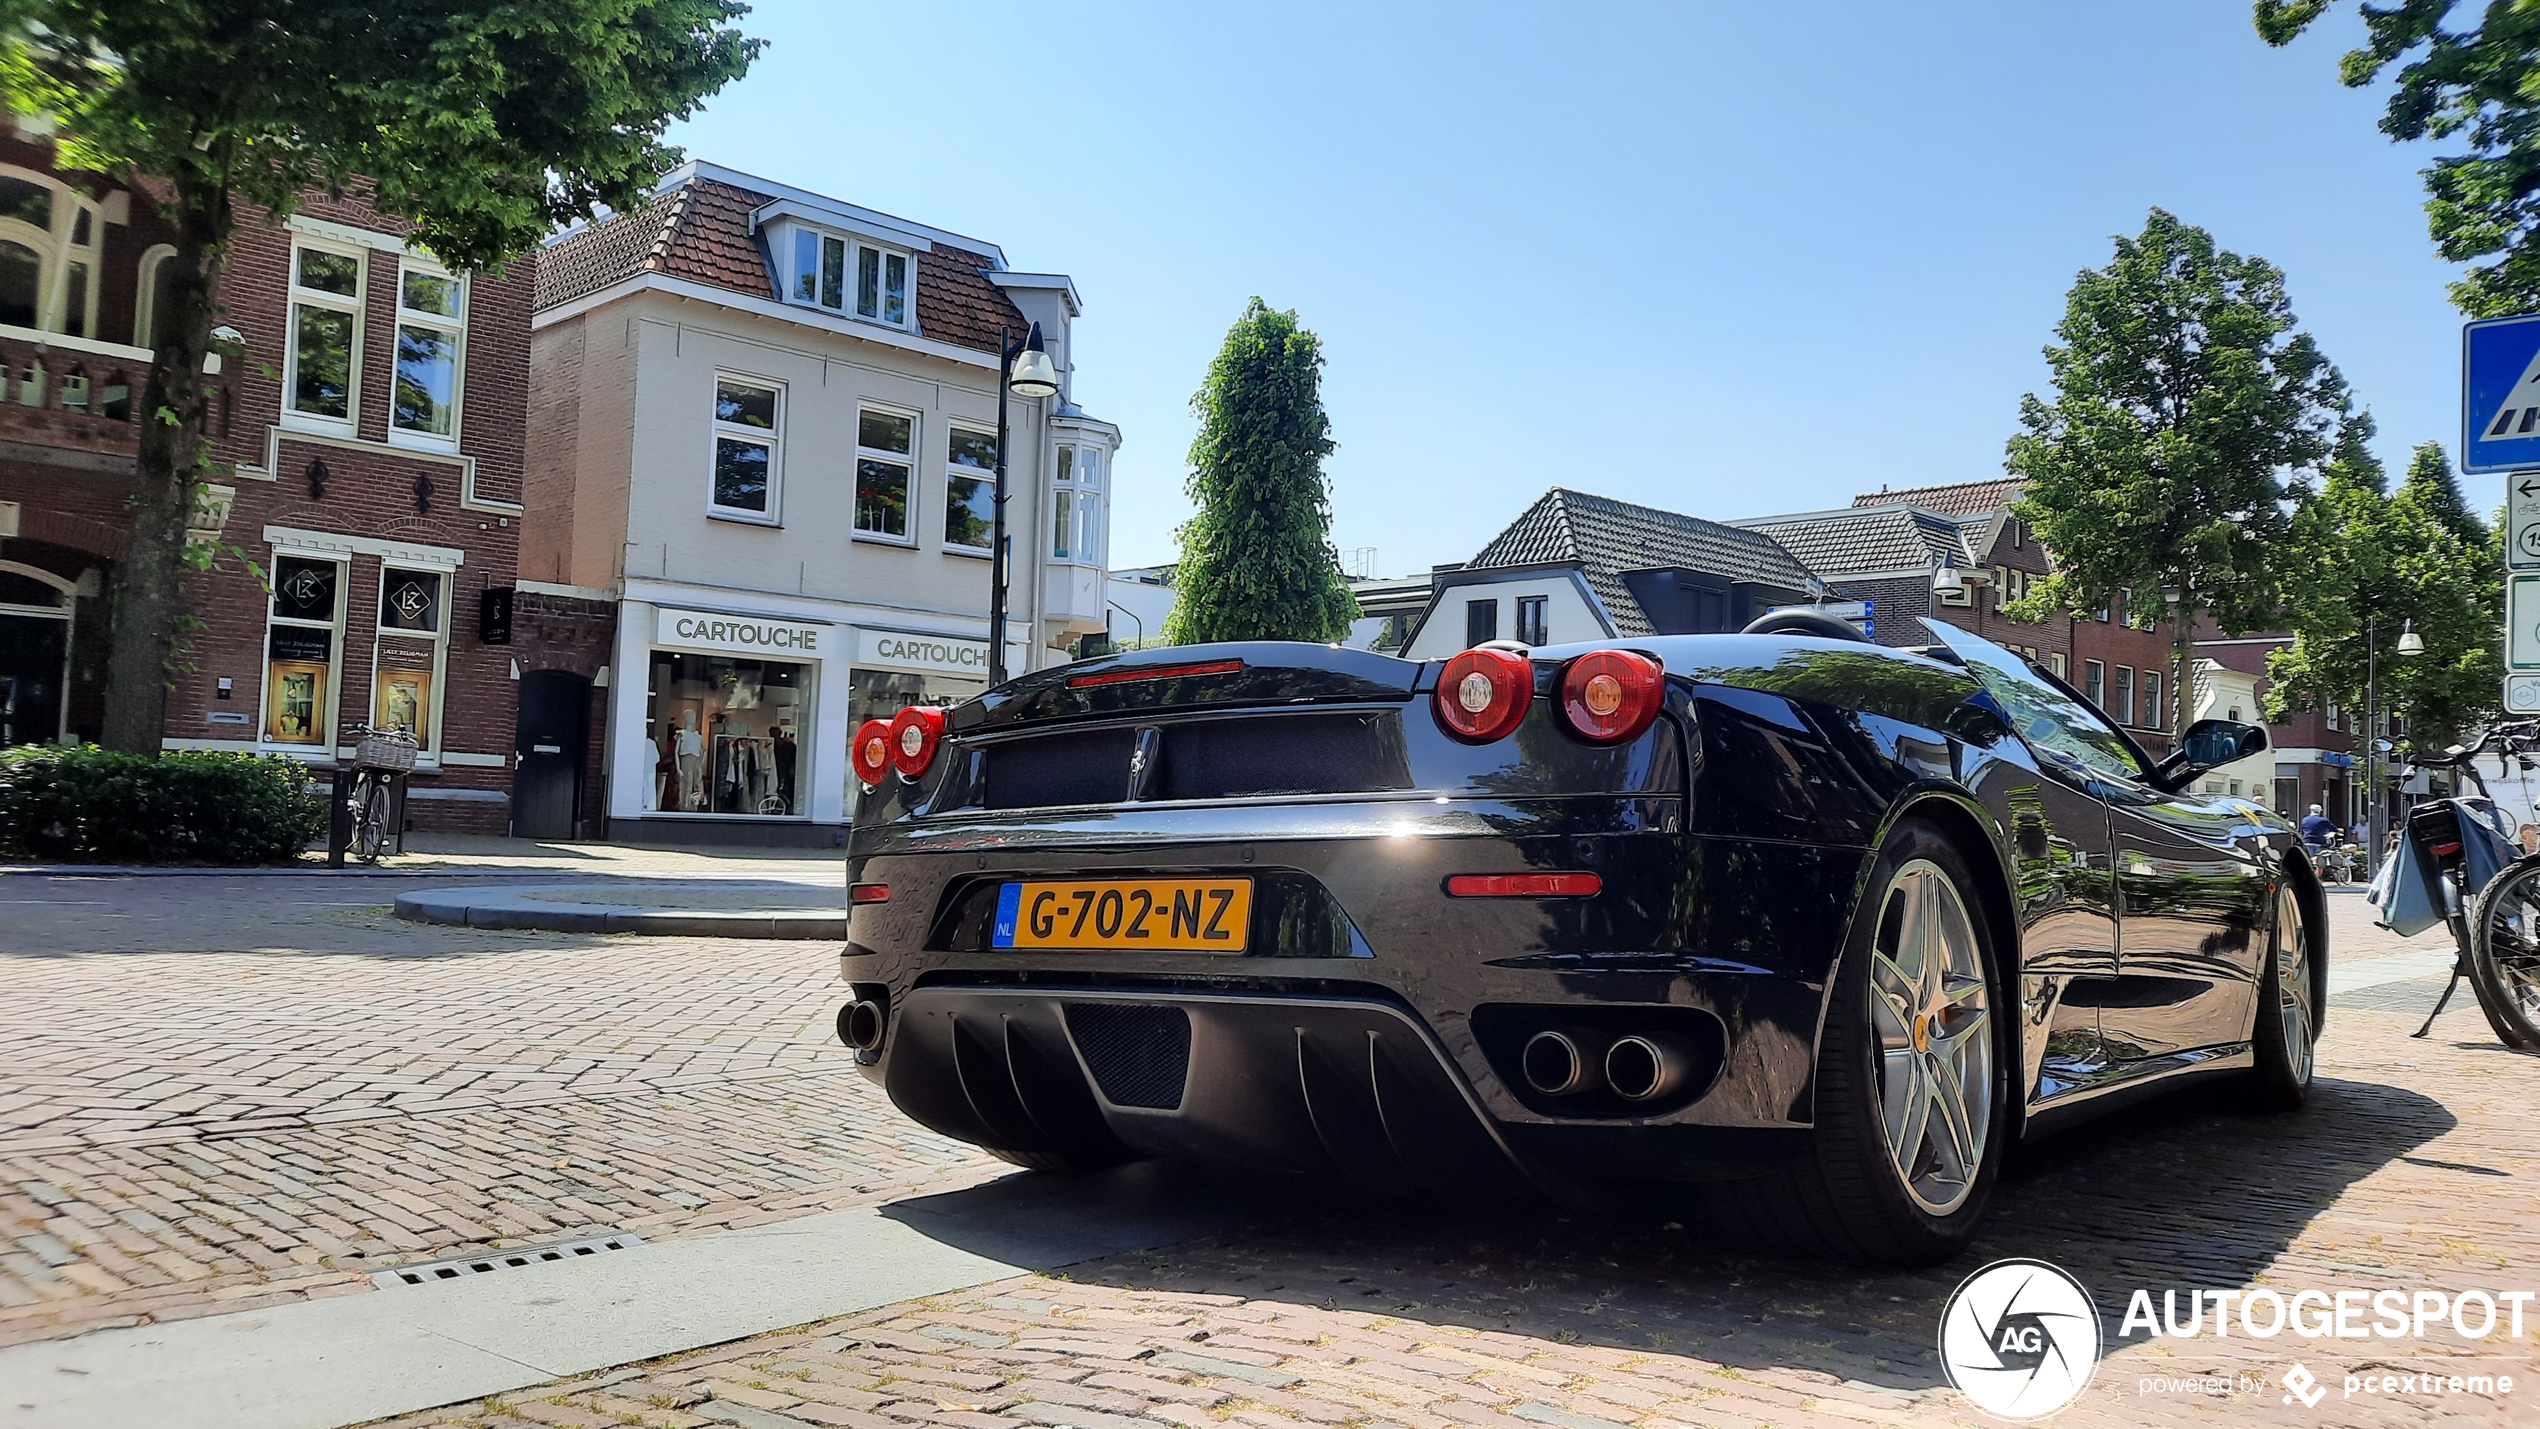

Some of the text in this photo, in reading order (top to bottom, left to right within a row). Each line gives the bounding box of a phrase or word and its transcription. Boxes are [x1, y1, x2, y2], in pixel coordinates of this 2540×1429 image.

[676, 618, 817, 650] CARTOUCHE
[997, 922, 1013, 938] NL
[1030, 889, 1235, 940] G-702-NZ
